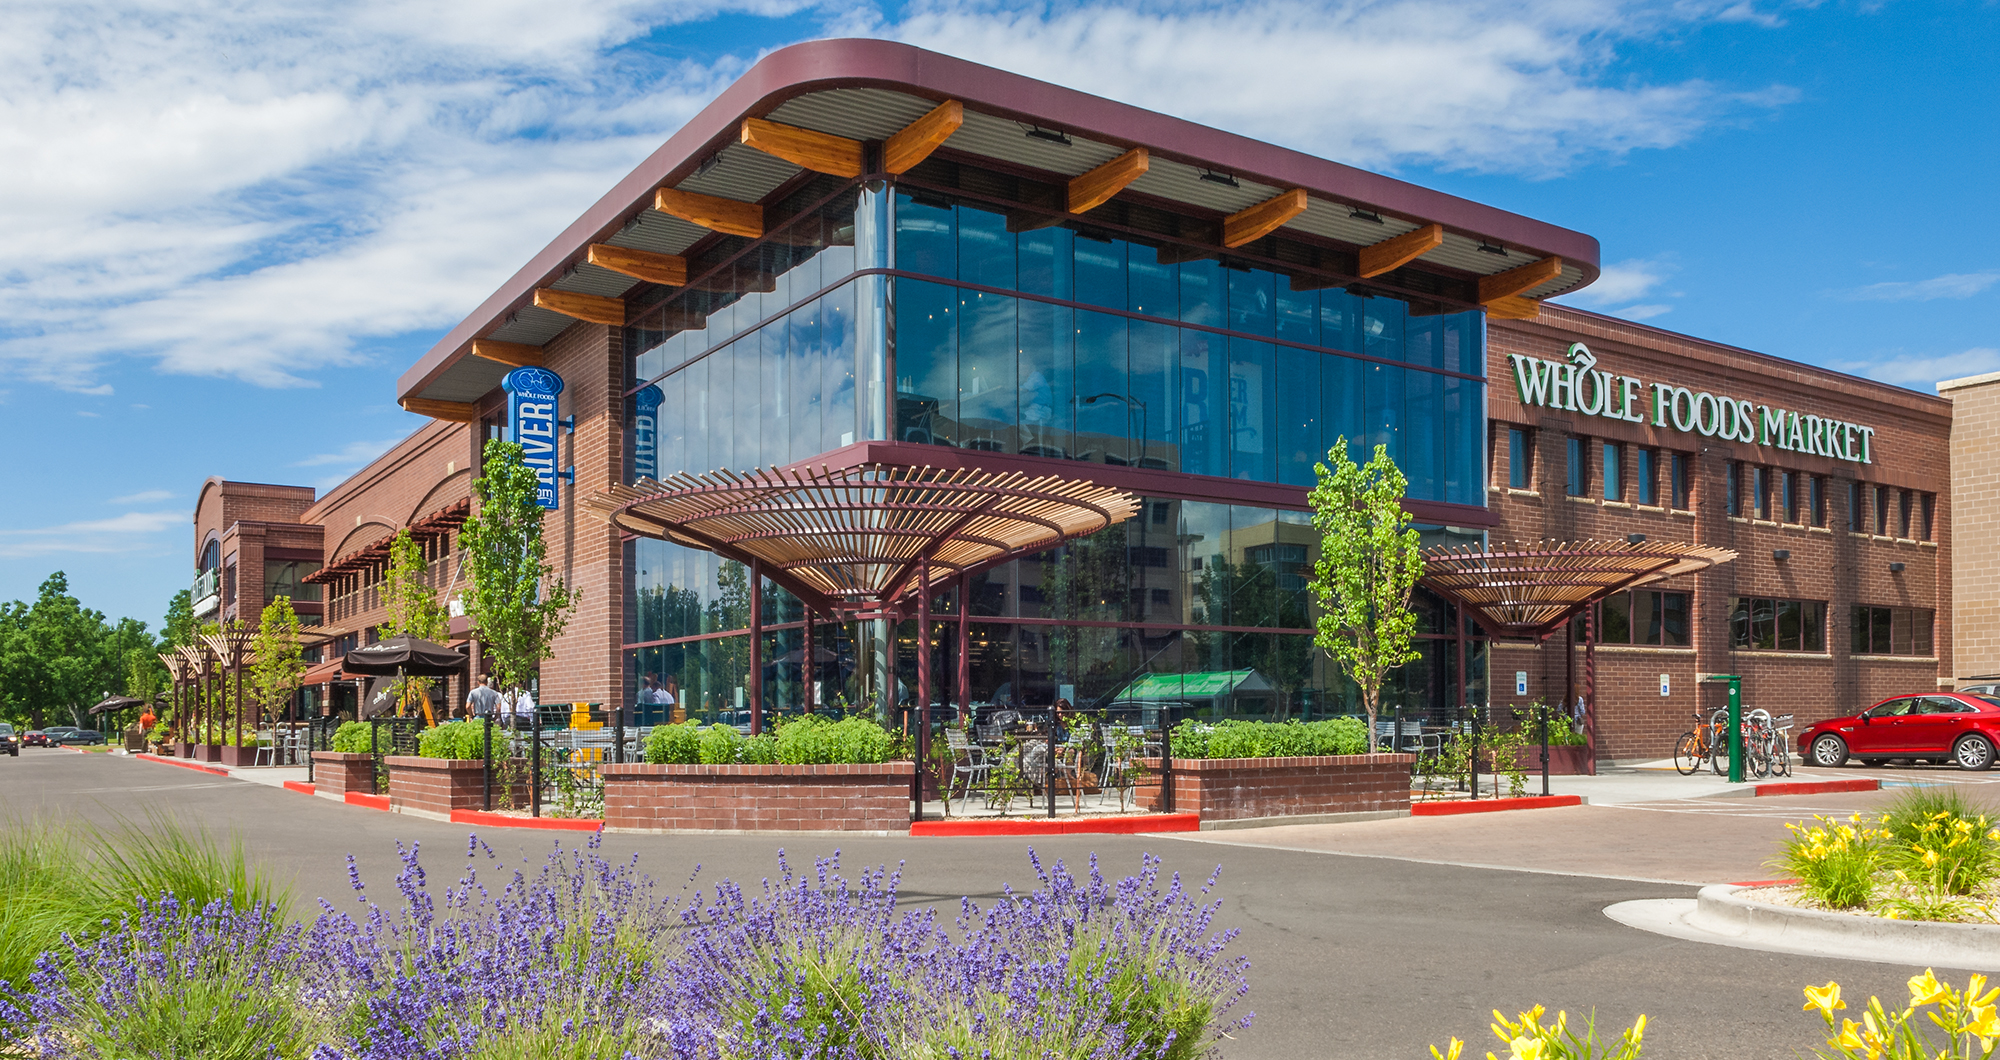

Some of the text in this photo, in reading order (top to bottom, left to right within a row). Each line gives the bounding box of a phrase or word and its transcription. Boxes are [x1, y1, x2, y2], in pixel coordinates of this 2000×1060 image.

[1508, 342, 1875, 465] WHOLE FOODS MARKET
